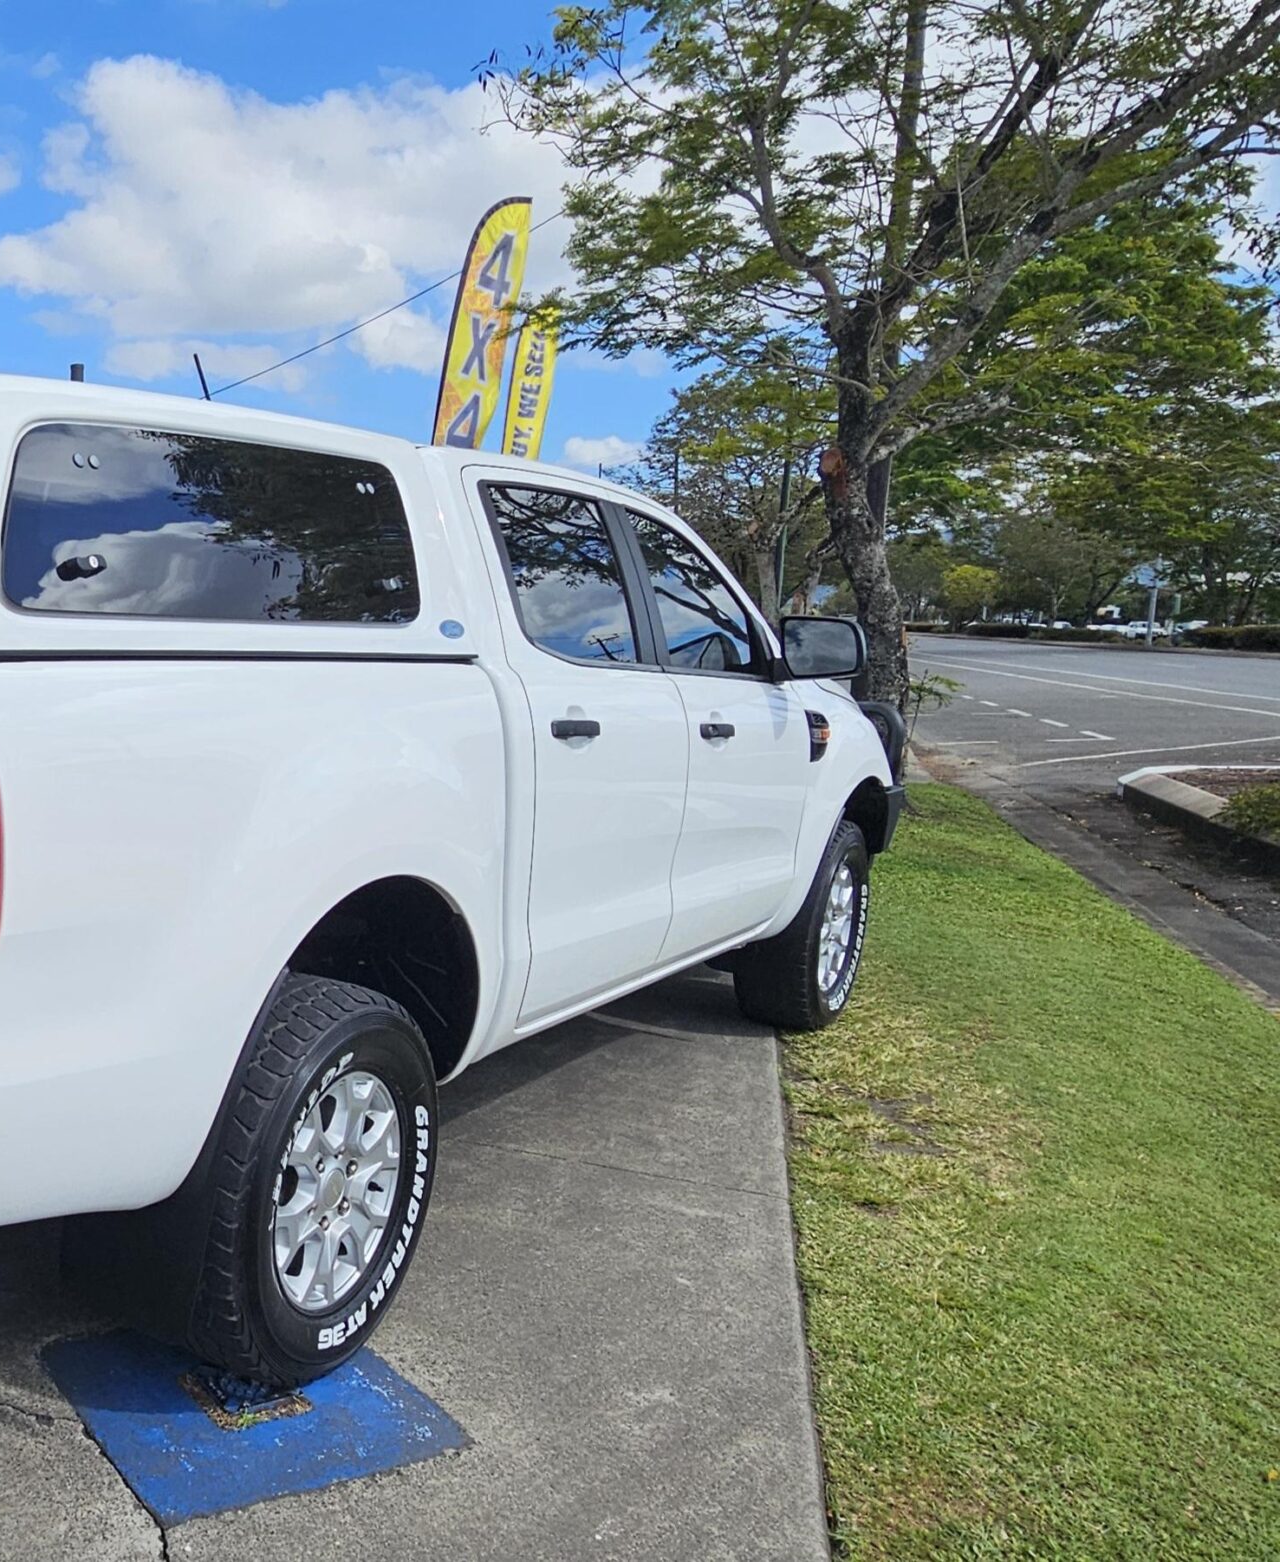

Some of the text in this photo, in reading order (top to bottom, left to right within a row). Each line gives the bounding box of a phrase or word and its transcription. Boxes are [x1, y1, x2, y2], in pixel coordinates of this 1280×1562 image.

[517, 383, 541, 418] WE
[510, 425, 534, 458] UY,
[369, 1105, 429, 1310] GRANDTREK
